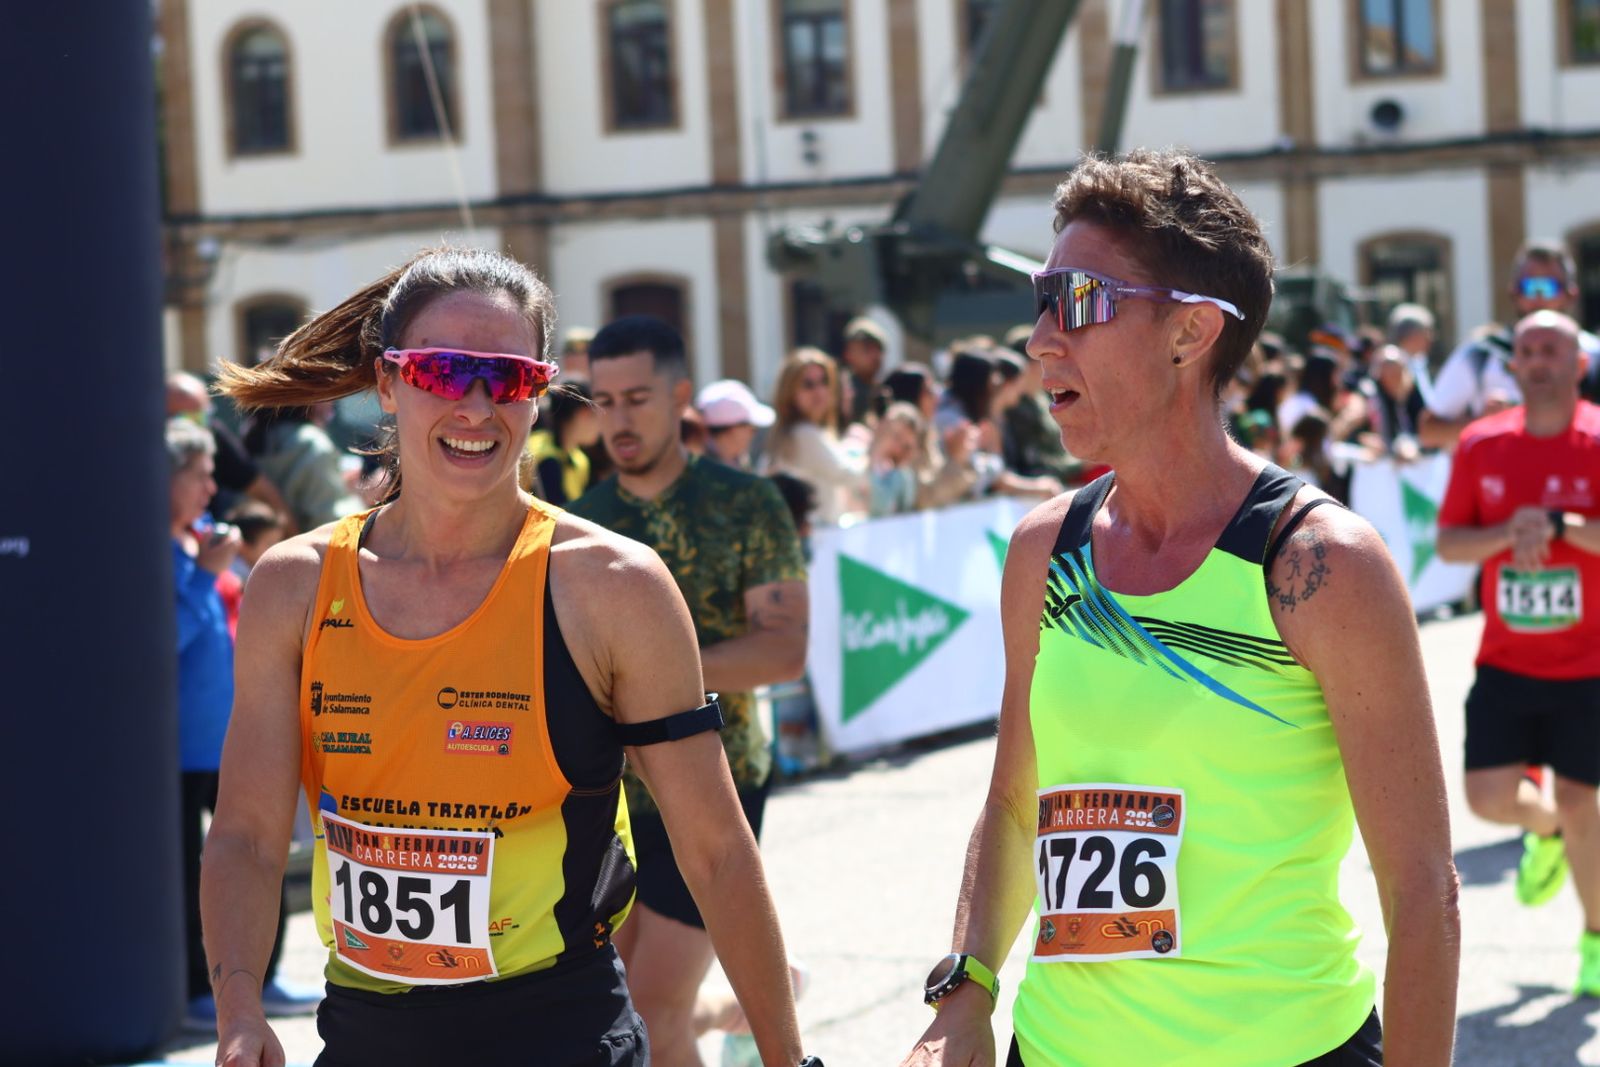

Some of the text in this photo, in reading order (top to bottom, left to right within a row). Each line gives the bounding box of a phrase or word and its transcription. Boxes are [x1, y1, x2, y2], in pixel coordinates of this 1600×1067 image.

[1504, 581, 1575, 615] 1514
[459, 700, 530, 711] CLÍNICA DENTAL
[460, 691, 484, 699] ESTER
[330, 704, 370, 714] Salamanca
[447, 743, 495, 752] AUTOESCUELA
[341, 795, 532, 819] ESCUELA TRIATLÓN
[1124, 810, 1156, 828] 202
[355, 831, 484, 855] SAN FERNANDO
[356, 844, 433, 868] CARRERA
[1039, 836, 1166, 911] 1726
[335, 860, 472, 945] 1851
